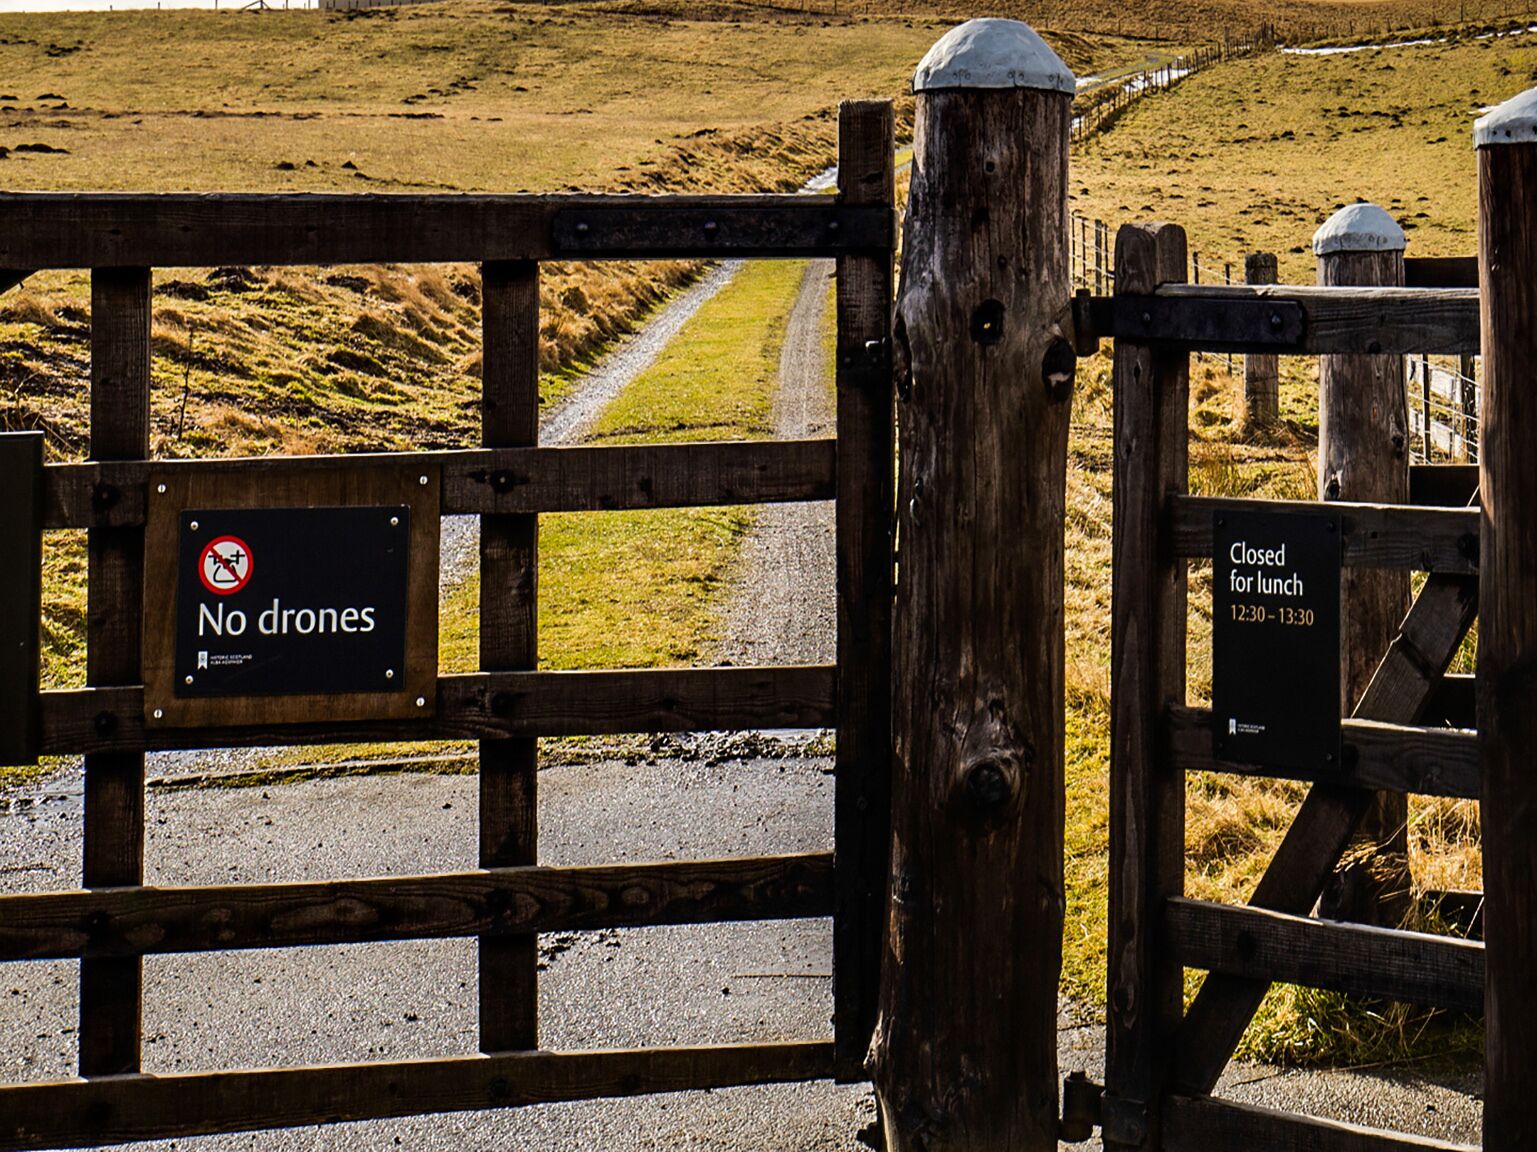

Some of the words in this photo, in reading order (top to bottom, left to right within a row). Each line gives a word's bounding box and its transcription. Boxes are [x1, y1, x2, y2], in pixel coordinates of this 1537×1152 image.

[1231, 541, 1285, 566] Closed
[1230, 569, 1253, 592] for
[1258, 571, 1302, 595] lunch
[199, 603, 246, 636] No
[259, 598, 374, 634] drones
[1232, 605, 1265, 622] 12:30
[1279, 608, 1313, 625] 13:30
